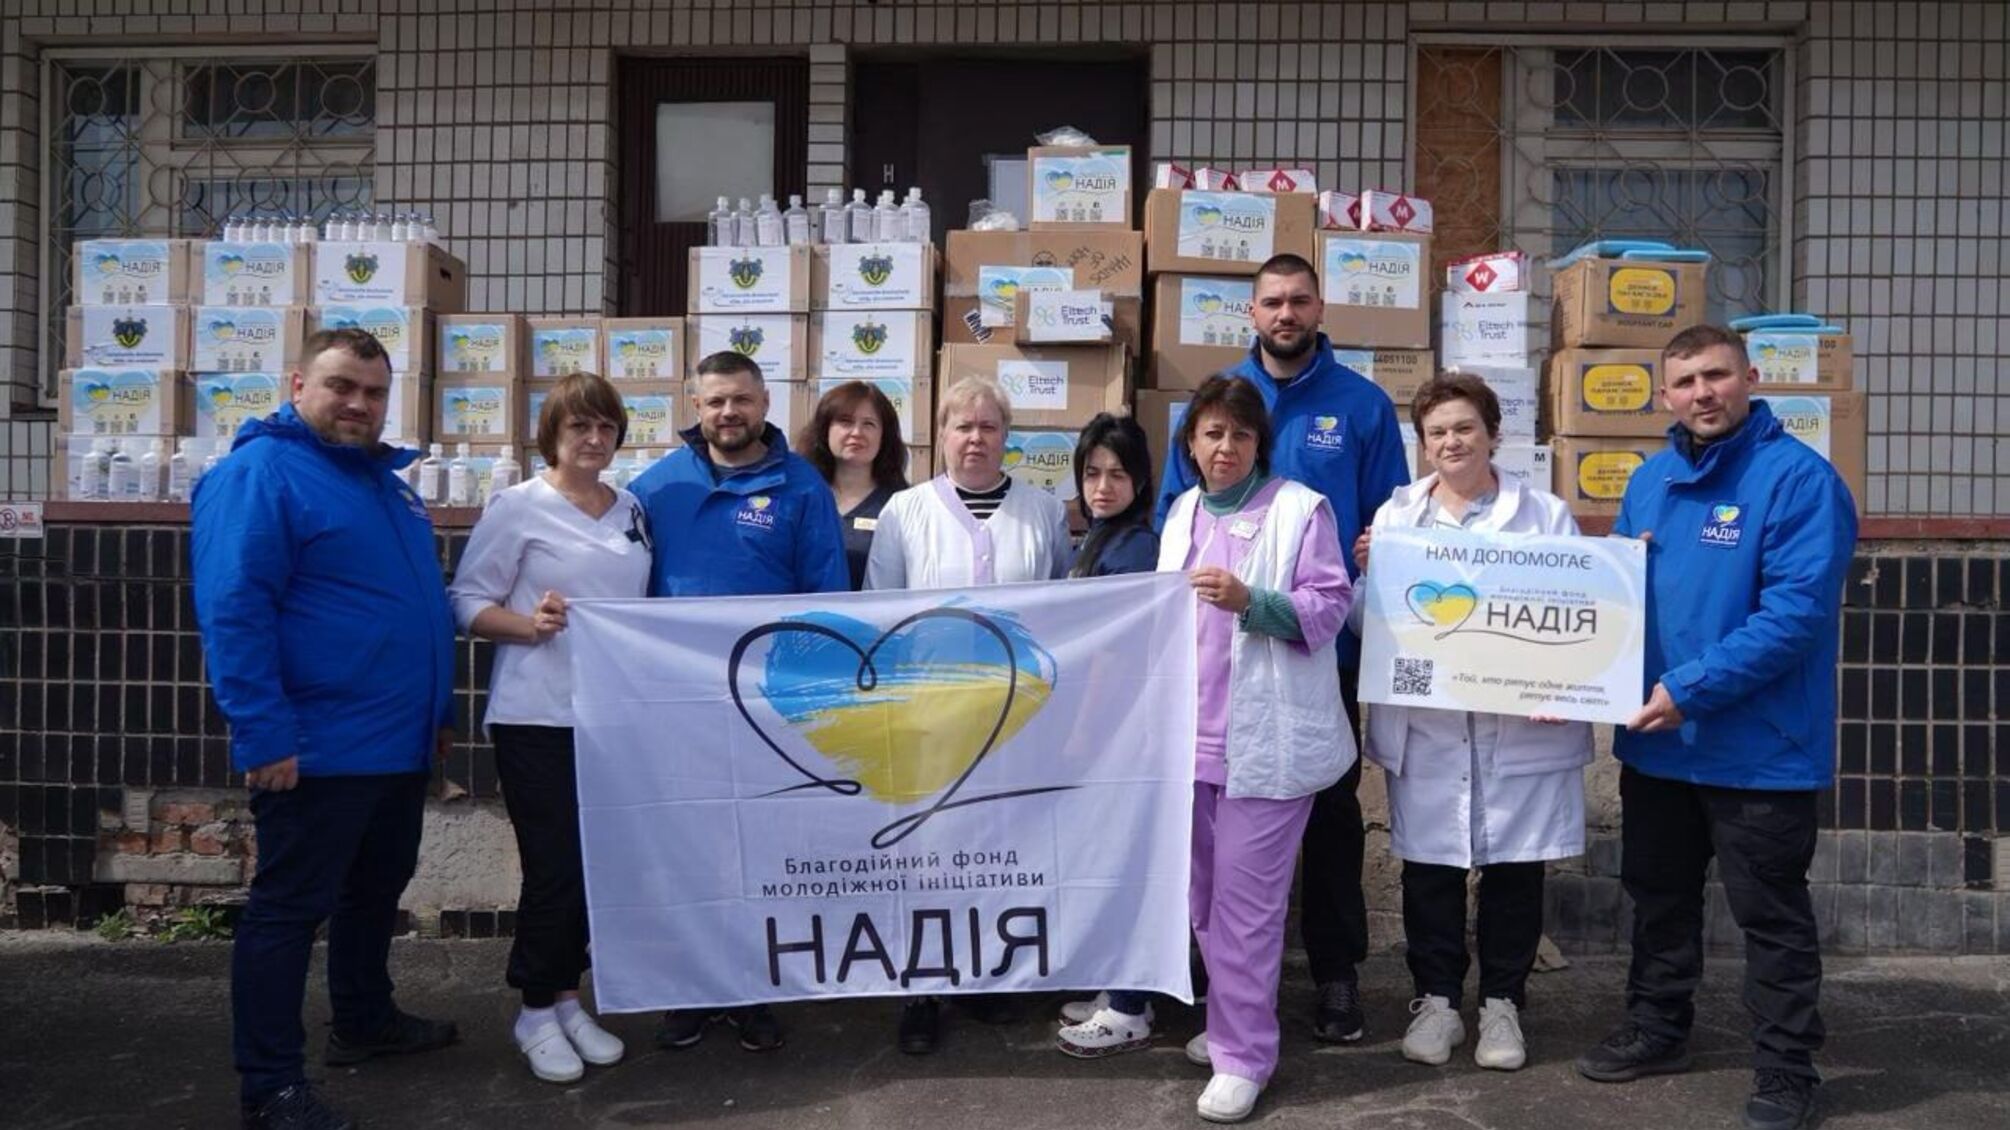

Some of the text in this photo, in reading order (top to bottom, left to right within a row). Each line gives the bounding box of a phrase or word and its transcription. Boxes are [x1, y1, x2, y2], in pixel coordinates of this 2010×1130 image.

[1075, 178, 1117, 190] НАДІЯ
[1223, 214, 1264, 228] НАДІЯ
[121, 261, 161, 273] НАДІЯ
[245, 261, 286, 273] НАДІЯ
[1369, 262, 1410, 274] НАДІЯ
[1061, 305, 1097, 315] Eltech
[1224, 302, 1251, 313] НАД
[1062, 315, 1090, 325] Trust
[1478, 320, 1514, 330] Eltech
[237, 327, 276, 340] НАДІЯ
[369, 326, 400, 338] АДІЯ
[1480, 330, 1507, 340] Trust
[470, 338, 499, 347] НАДІЯ
[561, 343, 590, 352] НАДІЯ
[637, 344, 666, 354] НАДІЯ
[1778, 348, 1811, 359] НАДІЯ
[1028, 375, 1065, 386] Eltech
[113, 389, 151, 401] НАДІЯ
[1028, 384, 1056, 395] Trust
[235, 392, 272, 404] НАДІЯ
[470, 401, 499, 410] НАДІЯ
[636, 411, 666, 420] НАДІЯ
[1307, 434, 1342, 445] НАДІЯ
[1026, 453, 1069, 466] НАДІЯ
[1534, 453, 1546, 462] M
[737, 511, 774, 526] НАДІЯ
[1701, 526, 1741, 541] НАДІЯ
[1426, 546, 1592, 570] НАМ ДОПОМОГАЄ
[1487, 602, 1597, 634] НАДІЯ
[1539, 680, 1563, 690] одне
[1519, 691, 1552, 702] рятує
[1555, 695, 1577, 704] весь
[785, 850, 1018, 876] Благодійний фонд
[762, 871, 1044, 898] молодіжної ініціативи
[766, 906, 1049, 988] НАДІЯ
